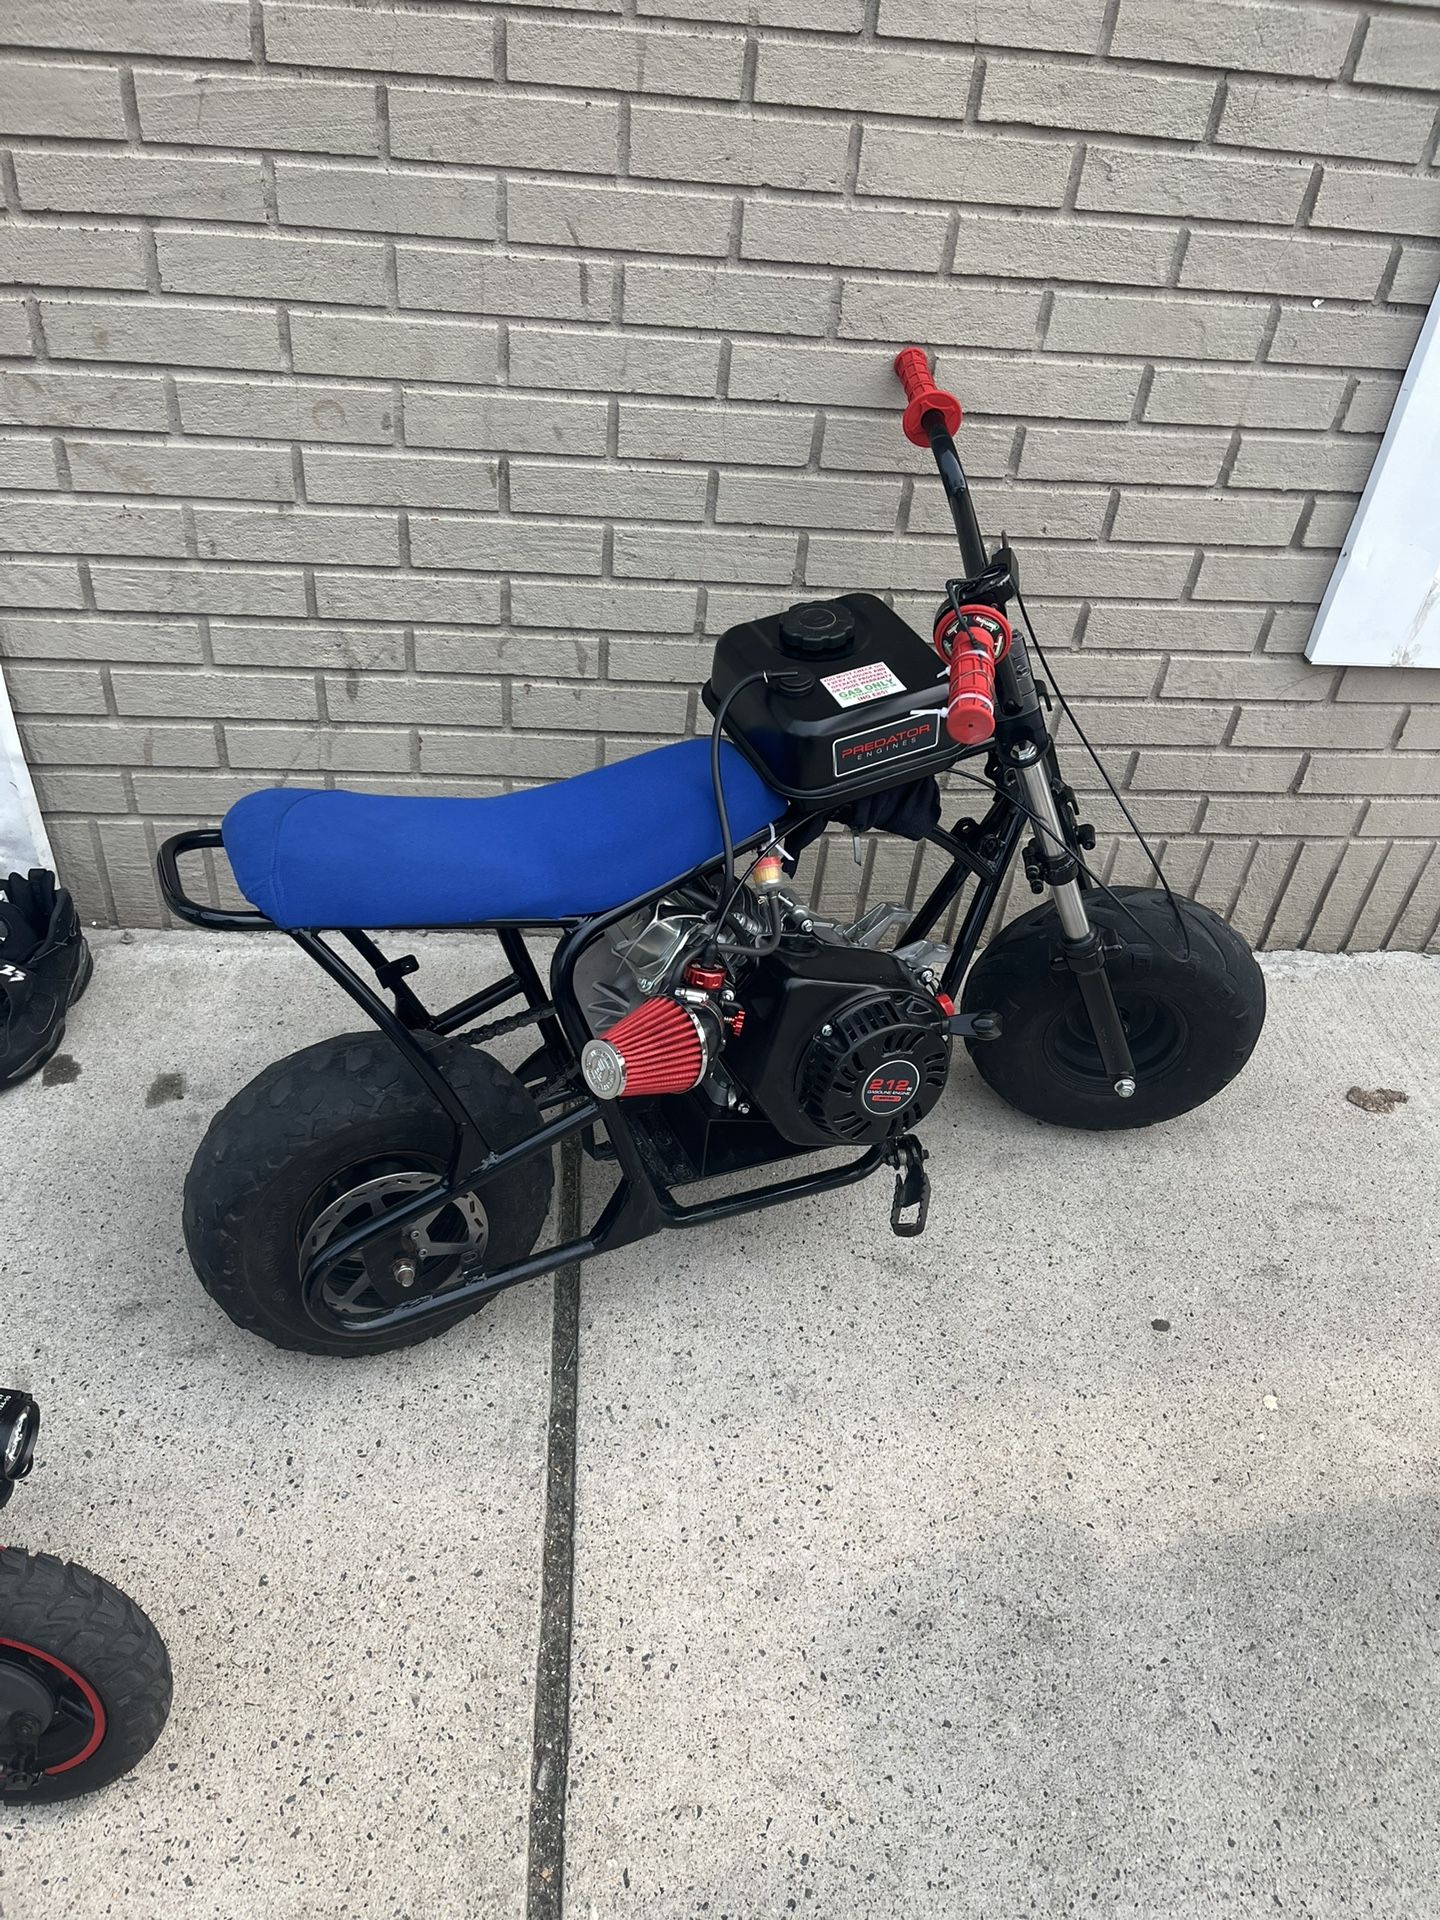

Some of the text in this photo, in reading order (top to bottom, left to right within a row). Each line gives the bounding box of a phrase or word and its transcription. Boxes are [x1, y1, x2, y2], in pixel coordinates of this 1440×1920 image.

[839, 687, 863, 698] GAS
[864, 678, 894, 691] ONLY
[842, 724, 930, 758] PREDATOR
[857, 738, 916, 760] ENGINES
[0, 964, 26, 982] 23
[869, 1079, 909, 1091] 212
